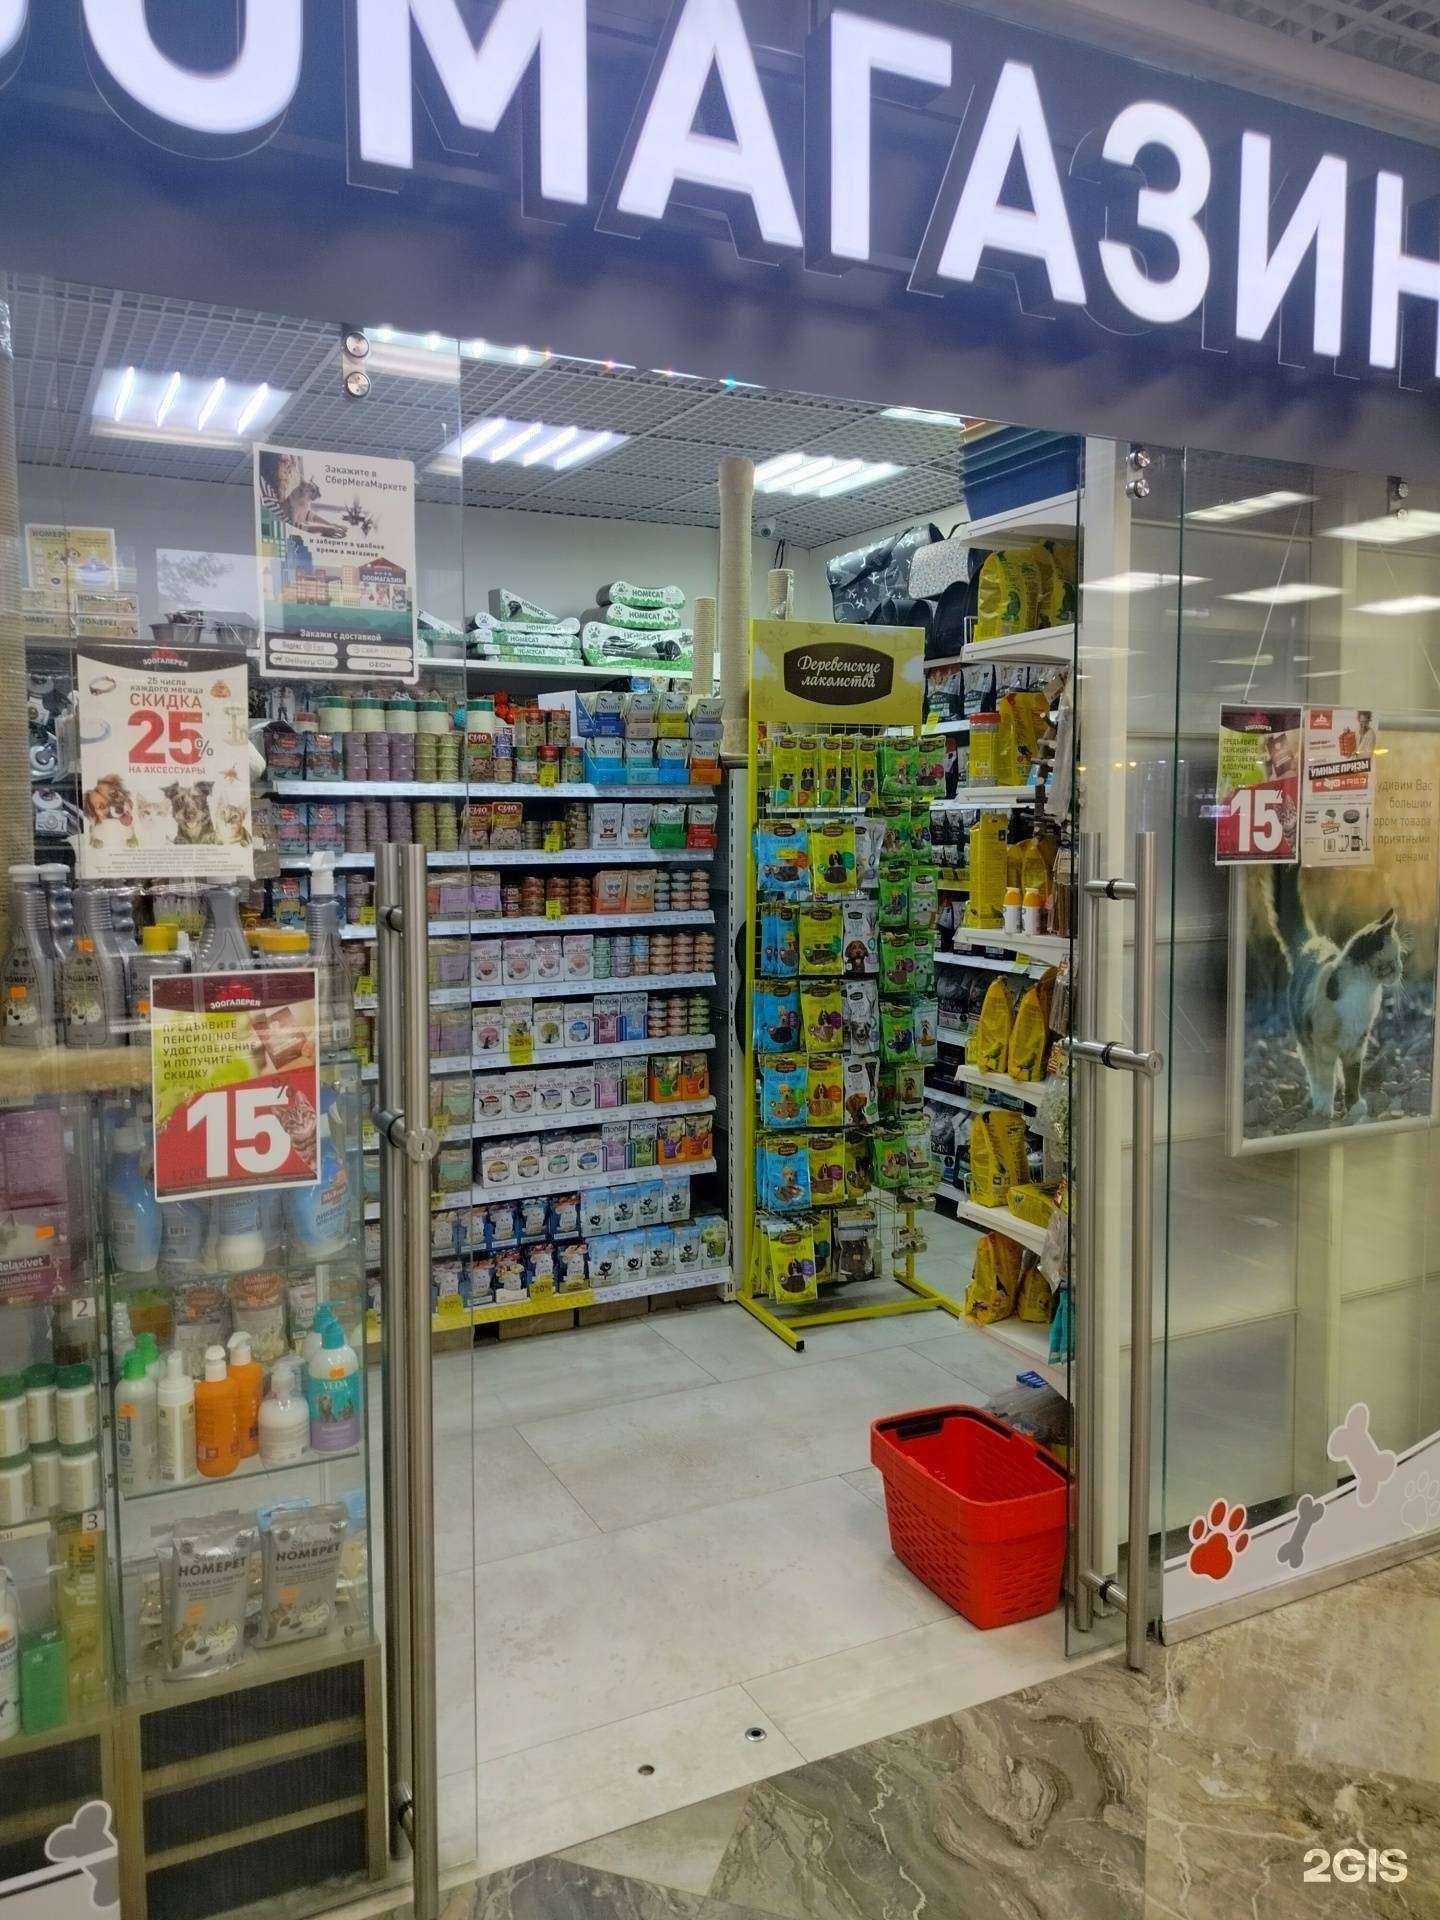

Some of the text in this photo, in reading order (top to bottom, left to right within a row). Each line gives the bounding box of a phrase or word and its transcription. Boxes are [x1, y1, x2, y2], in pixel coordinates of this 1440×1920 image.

[0, 0, 1440, 370] МАГАЗИН
[325, 464, 370, 477] Закажите
[325, 475, 408, 492] СберМегаМаркете
[632, 589, 664, 598] HOMECAT
[629, 611, 661, 620] HOMECAT
[301, 629, 332, 639] Закажи
[339, 632, 382, 642] доставкой
[798, 655, 881, 675] Деревенские
[147, 677, 186, 687] 25 числа
[801, 673, 876, 688] лакомства
[130, 685, 204, 695] каждого месяца
[129, 692, 203, 710] СКИДКА
[128, 766, 206, 776] НА АКСЕССУАРЫ
[1311, 761, 1369, 778] УМНЫЕ ПРИЗЫ
[1415, 778, 1433, 791] Вас
[1389, 796, 1433, 808] большим
[210, 998, 261, 1010] ЗООГАЛЕРЕЯ
[163, 1041, 257, 1057] УДОСТОВЕРЕНИЕ
[164, 1055, 232, 1069] И ПОЛУЧИТЕ
[164, 1068, 208, 1080] СКИДКУ
[77, 1300, 88, 1318] 2
[322, 1379, 348, 1391] VEDA
[86, 1512, 98, 1531] 3
[277, 1542, 339, 1562] HOMEPET
[178, 1556, 246, 1577] HOMEPET
